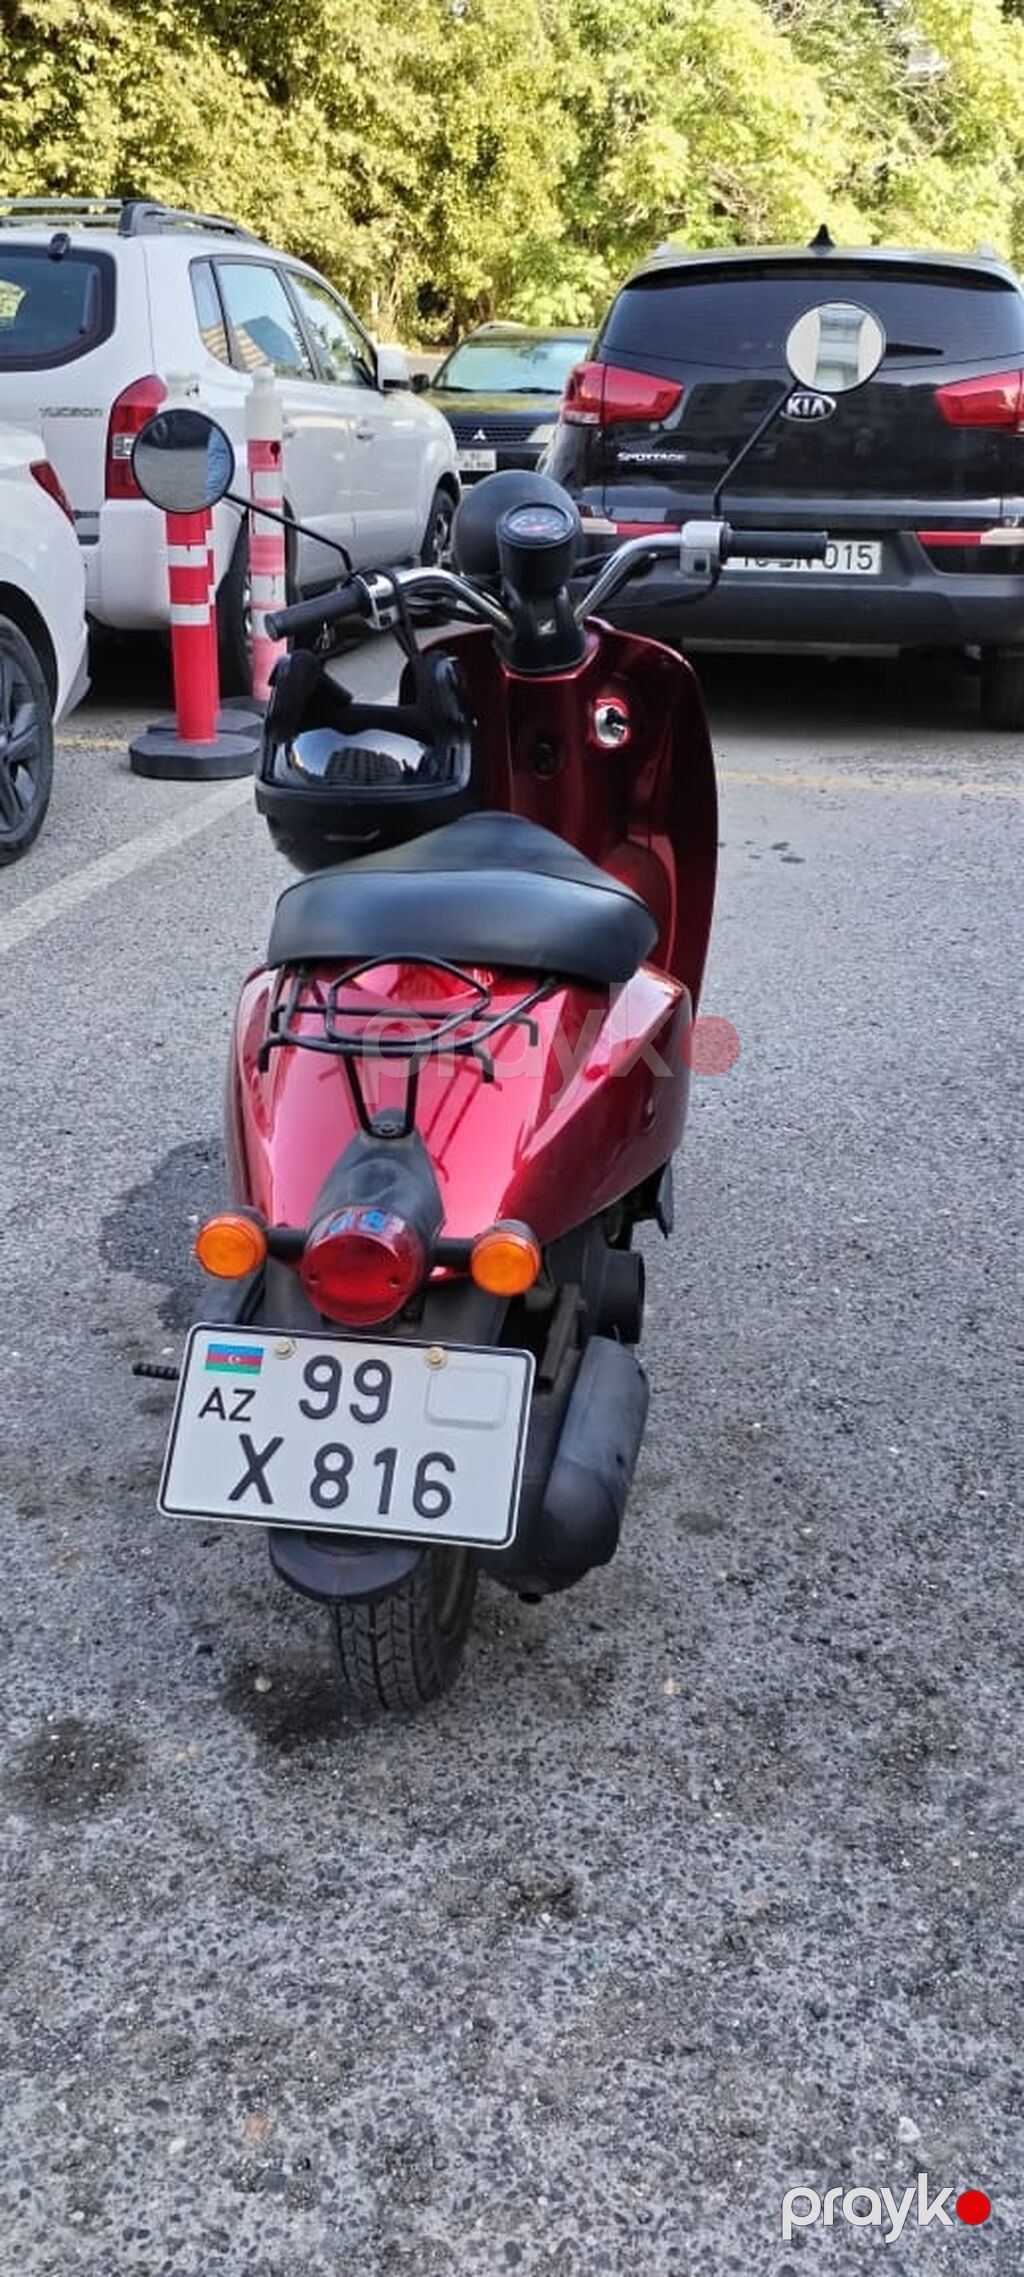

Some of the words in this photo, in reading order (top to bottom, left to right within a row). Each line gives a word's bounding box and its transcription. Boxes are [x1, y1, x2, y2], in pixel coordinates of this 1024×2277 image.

[786, 397, 825, 417] KIA
[824, 544, 873, 570] 015
[199, 1387, 256, 1422] AZ
[298, 1355, 392, 1424] 99
[228, 1434, 284, 1505] X
[310, 1442, 456, 1519] 816
